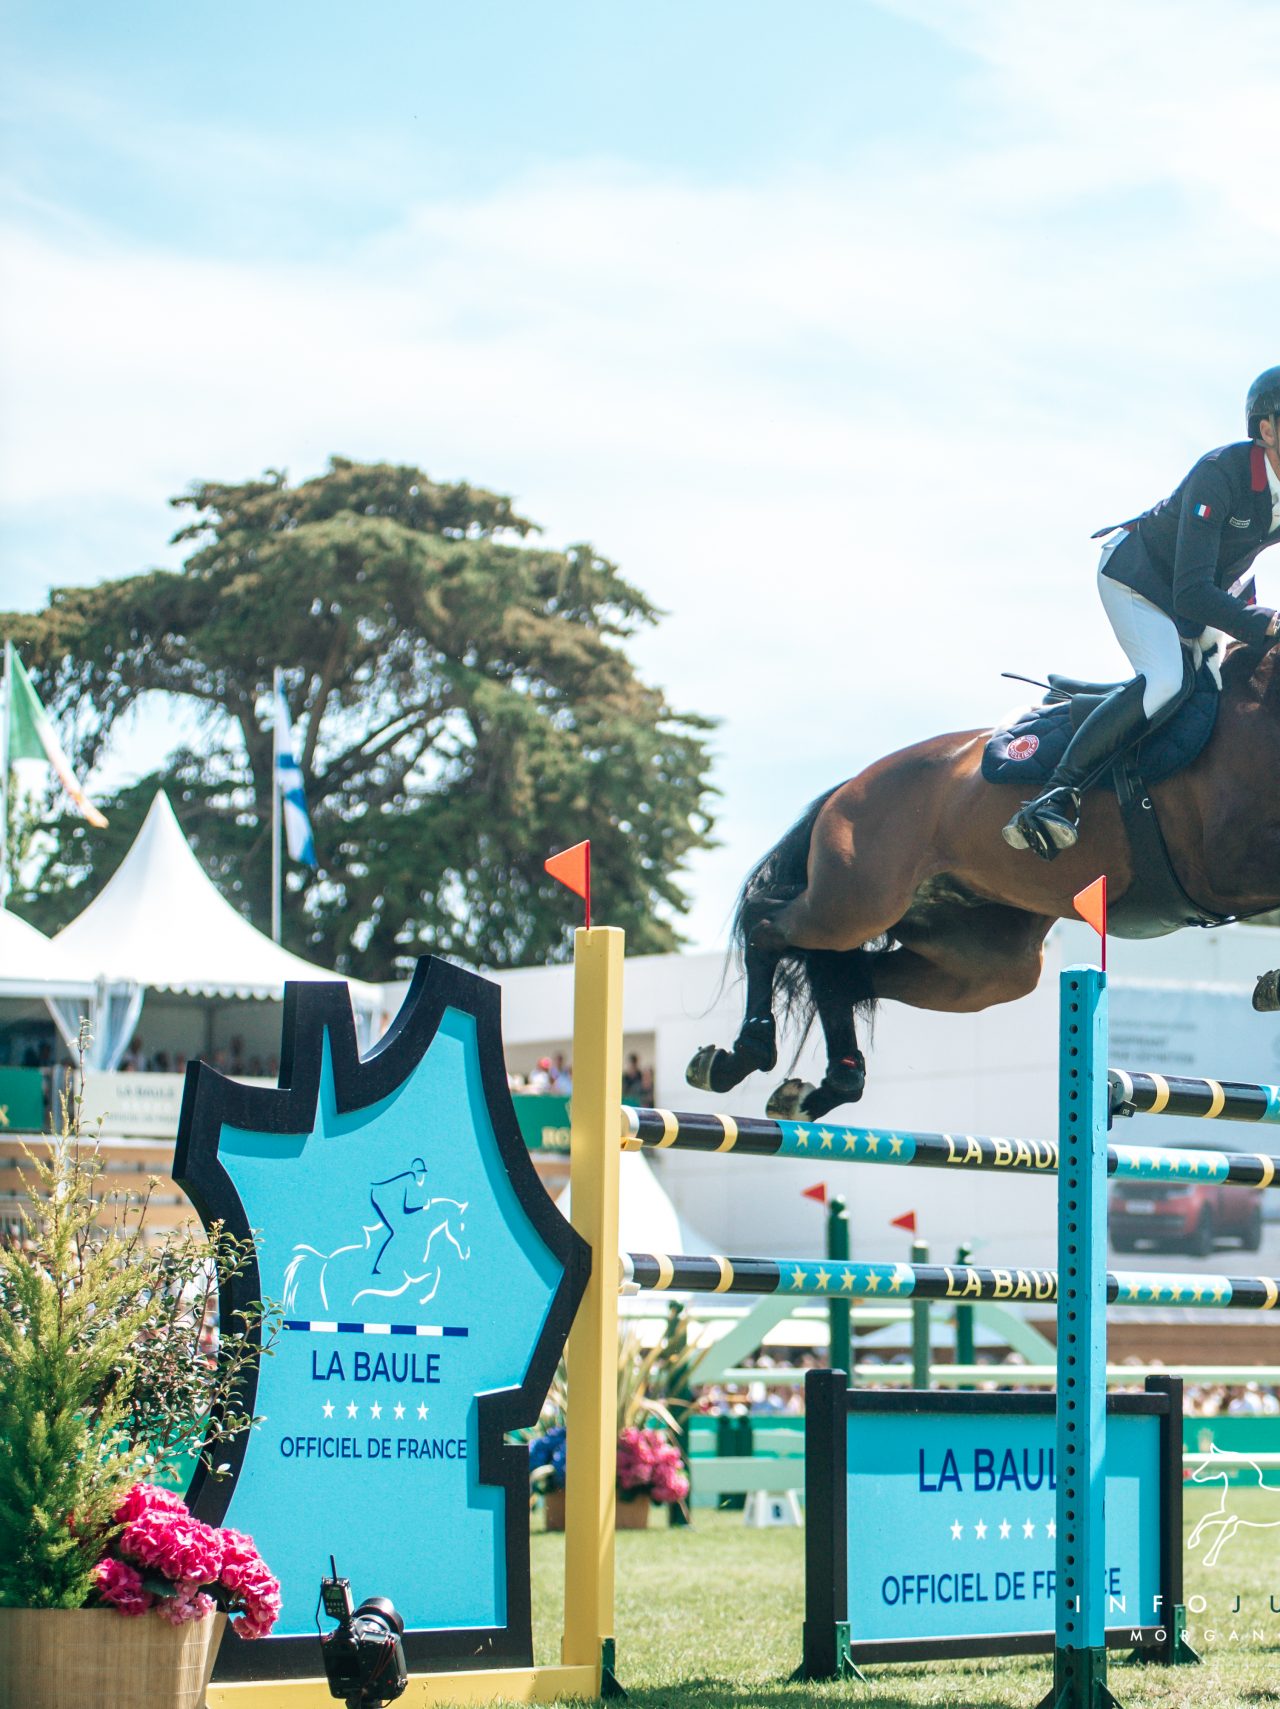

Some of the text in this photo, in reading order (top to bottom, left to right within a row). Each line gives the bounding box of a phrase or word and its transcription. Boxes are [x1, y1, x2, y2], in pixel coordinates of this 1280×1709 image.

[943, 1134, 1059, 1168] LA BAUL
[943, 1267, 1058, 1299] LA BAUL
[312, 1350, 441, 1384] LA BAULE
[280, 1436, 467, 1459] OFFICIEL DE FRANCE
[918, 1448, 1057, 1492] LA BAUL
[881, 1567, 1121, 1606] OFFICIEL DE FRE
